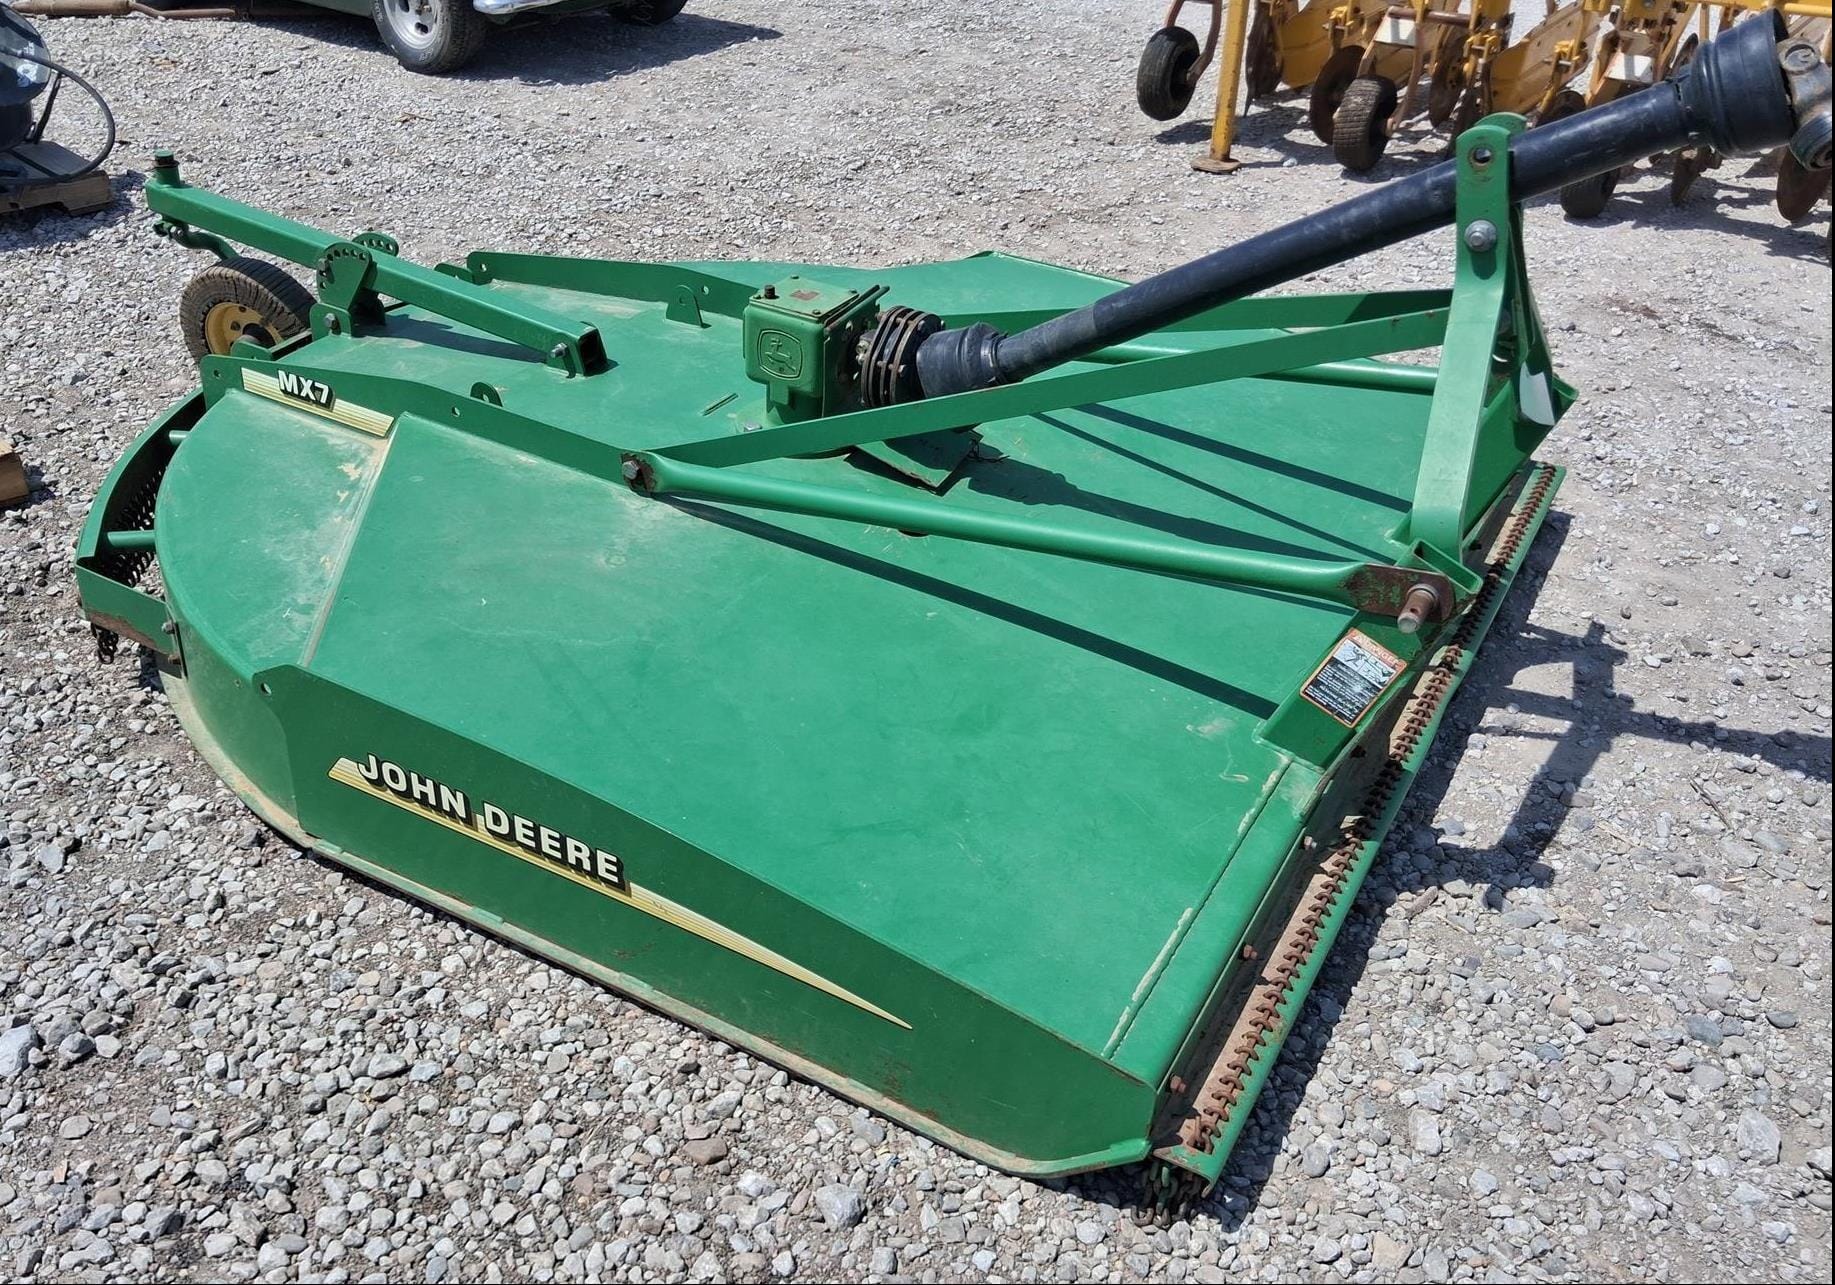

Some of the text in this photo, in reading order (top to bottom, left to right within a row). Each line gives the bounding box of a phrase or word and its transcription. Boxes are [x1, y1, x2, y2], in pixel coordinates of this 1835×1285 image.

[278, 370, 330, 404] MX7
[357, 754, 621, 884] JOHN DEERE
